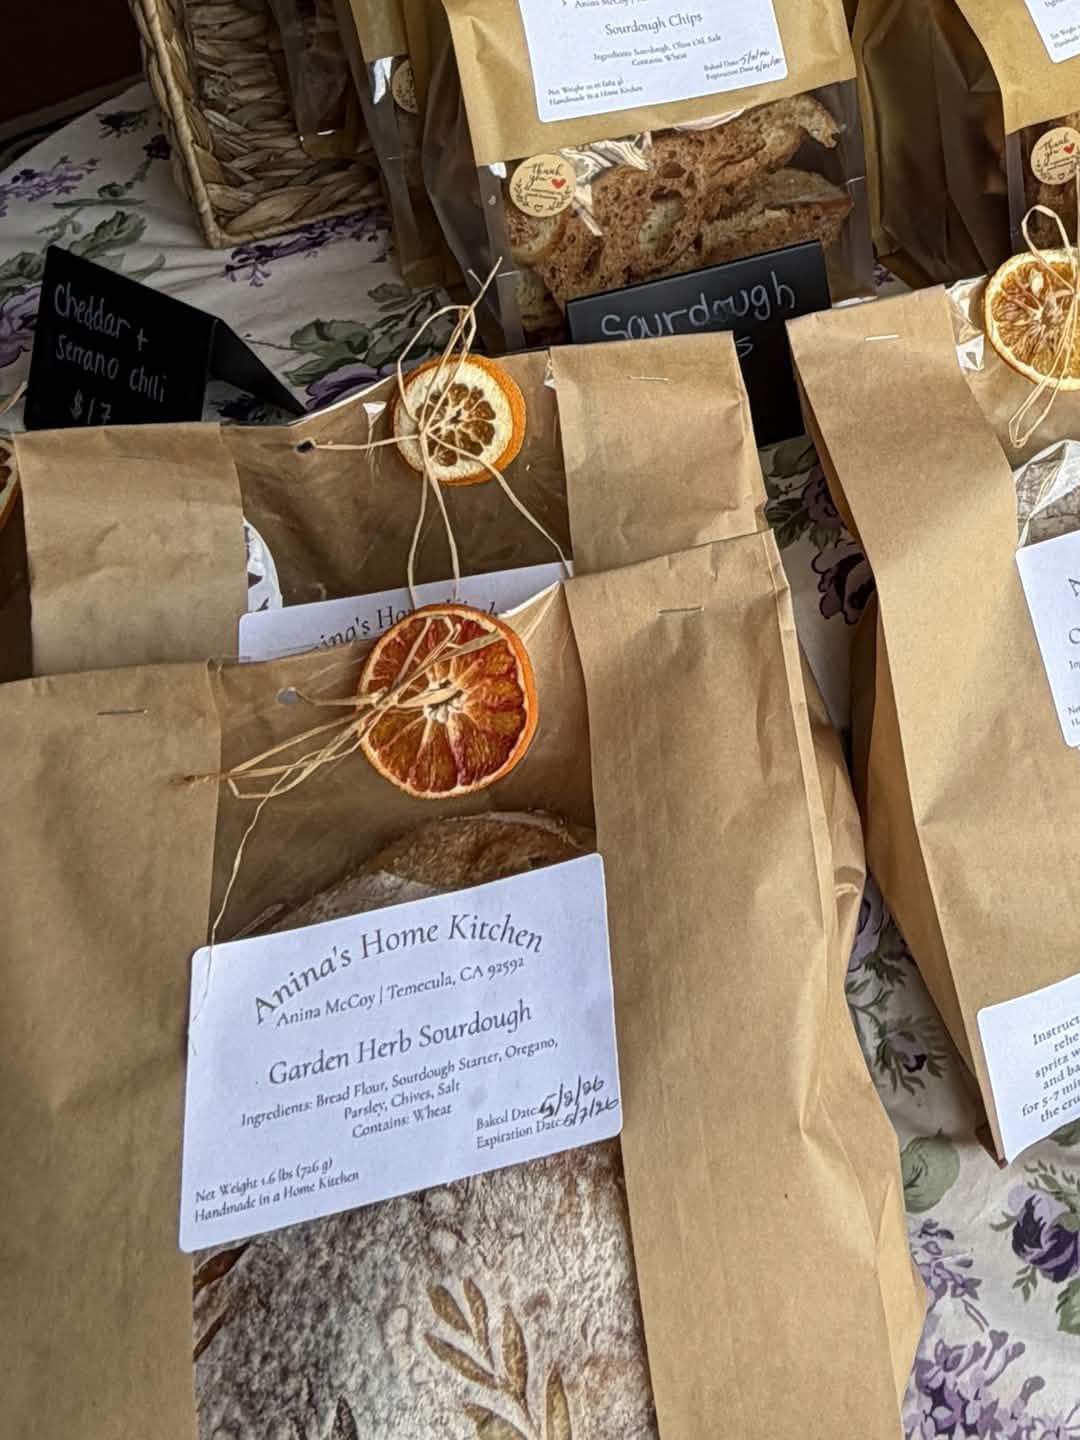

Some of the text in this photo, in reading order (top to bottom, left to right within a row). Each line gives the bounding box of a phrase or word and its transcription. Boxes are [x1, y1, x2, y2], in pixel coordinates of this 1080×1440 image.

[604, 12, 703, 37] Sourdough Chips
[54, 281, 132, 339] Cheddar
[254, 912, 543, 1026] Anina's Home Kitchen
[276, 957, 525, 1027] Anina McCoy Temecula, CA 92592
[268, 998, 532, 1086] Garden Herb Sourdough
[1034, 1052, 1070, 1079] spritz
[1042, 1072, 1065, 1091] and
[241, 1037, 559, 1129] Ingredients: Bread Flour, Sourdough Starter, Oregano,
[391, 1087, 435, 1108] Chives,
[437, 1078, 461, 1097] Salt
[351, 1103, 453, 1139] Contains: Wheat
[475, 1110, 508, 1131] Baked
[1021, 1100, 1040, 1118] for
[1041, 1091, 1060, 1108] 5-7
[1039, 1104, 1060, 1124] the
[476, 1122, 533, 1150] Expiration
[194, 1170, 360, 1223] Handmade in a Home Kitchen
[195, 1188, 216, 1204] Net
[219, 1179, 258, 1198] Weight
[261, 1170, 276, 1186] 1.6
[278, 1166, 294, 1182] lbs
[295, 1163, 318, 1181] (726
